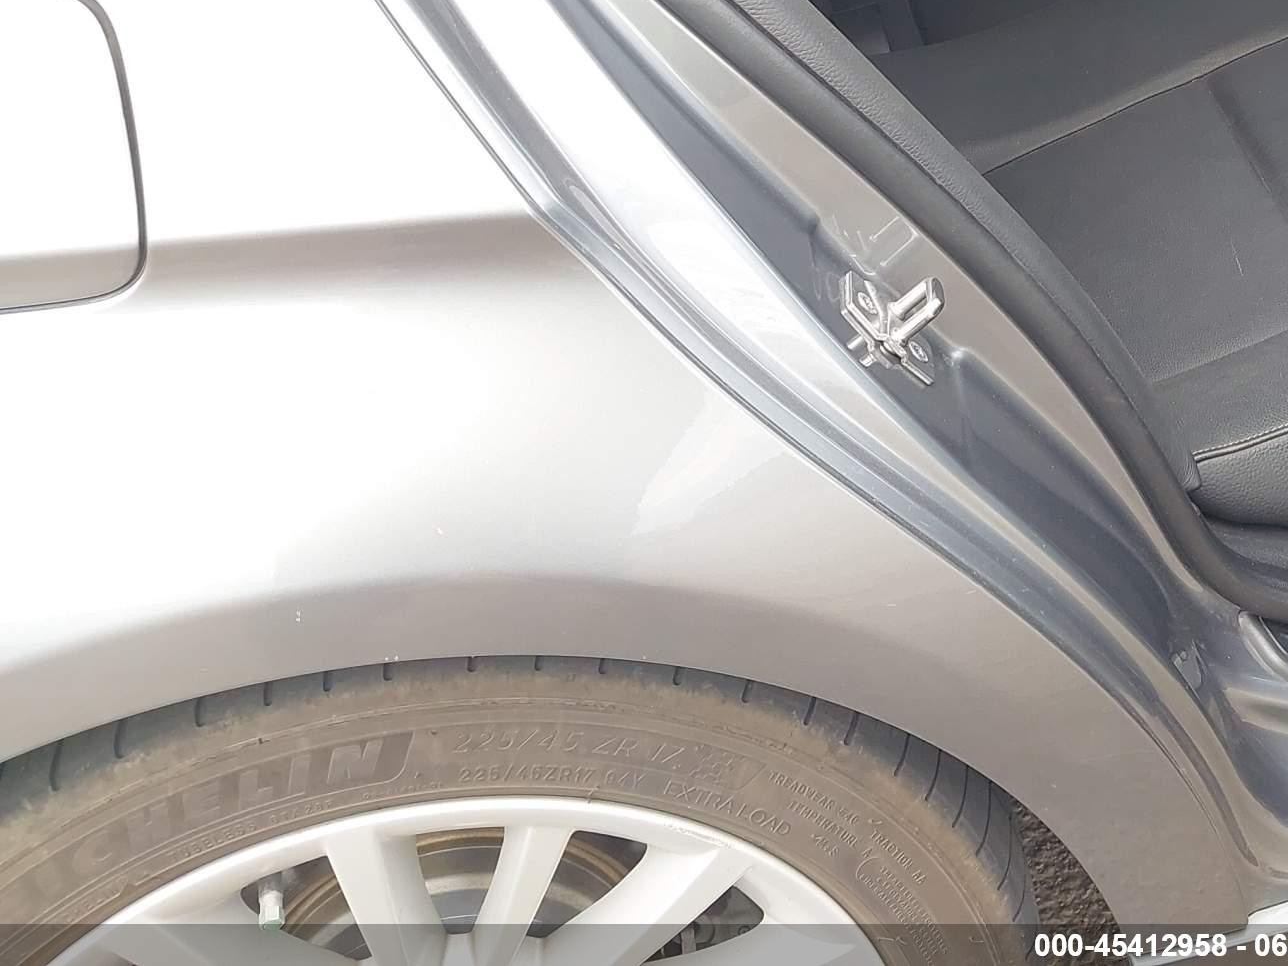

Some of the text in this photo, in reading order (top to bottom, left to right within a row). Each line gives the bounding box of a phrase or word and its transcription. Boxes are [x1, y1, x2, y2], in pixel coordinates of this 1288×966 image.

[453, 729, 584, 754] 225/45
[592, 737, 639, 757] ZR
[664, 780, 733, 815] EXTRA
[736, 803, 792, 837] LOAD
[768, 769, 837, 811] TREADWEAR
[788, 800, 858, 848] TEMPERATURE
[871, 827, 913, 870] TRACTION
